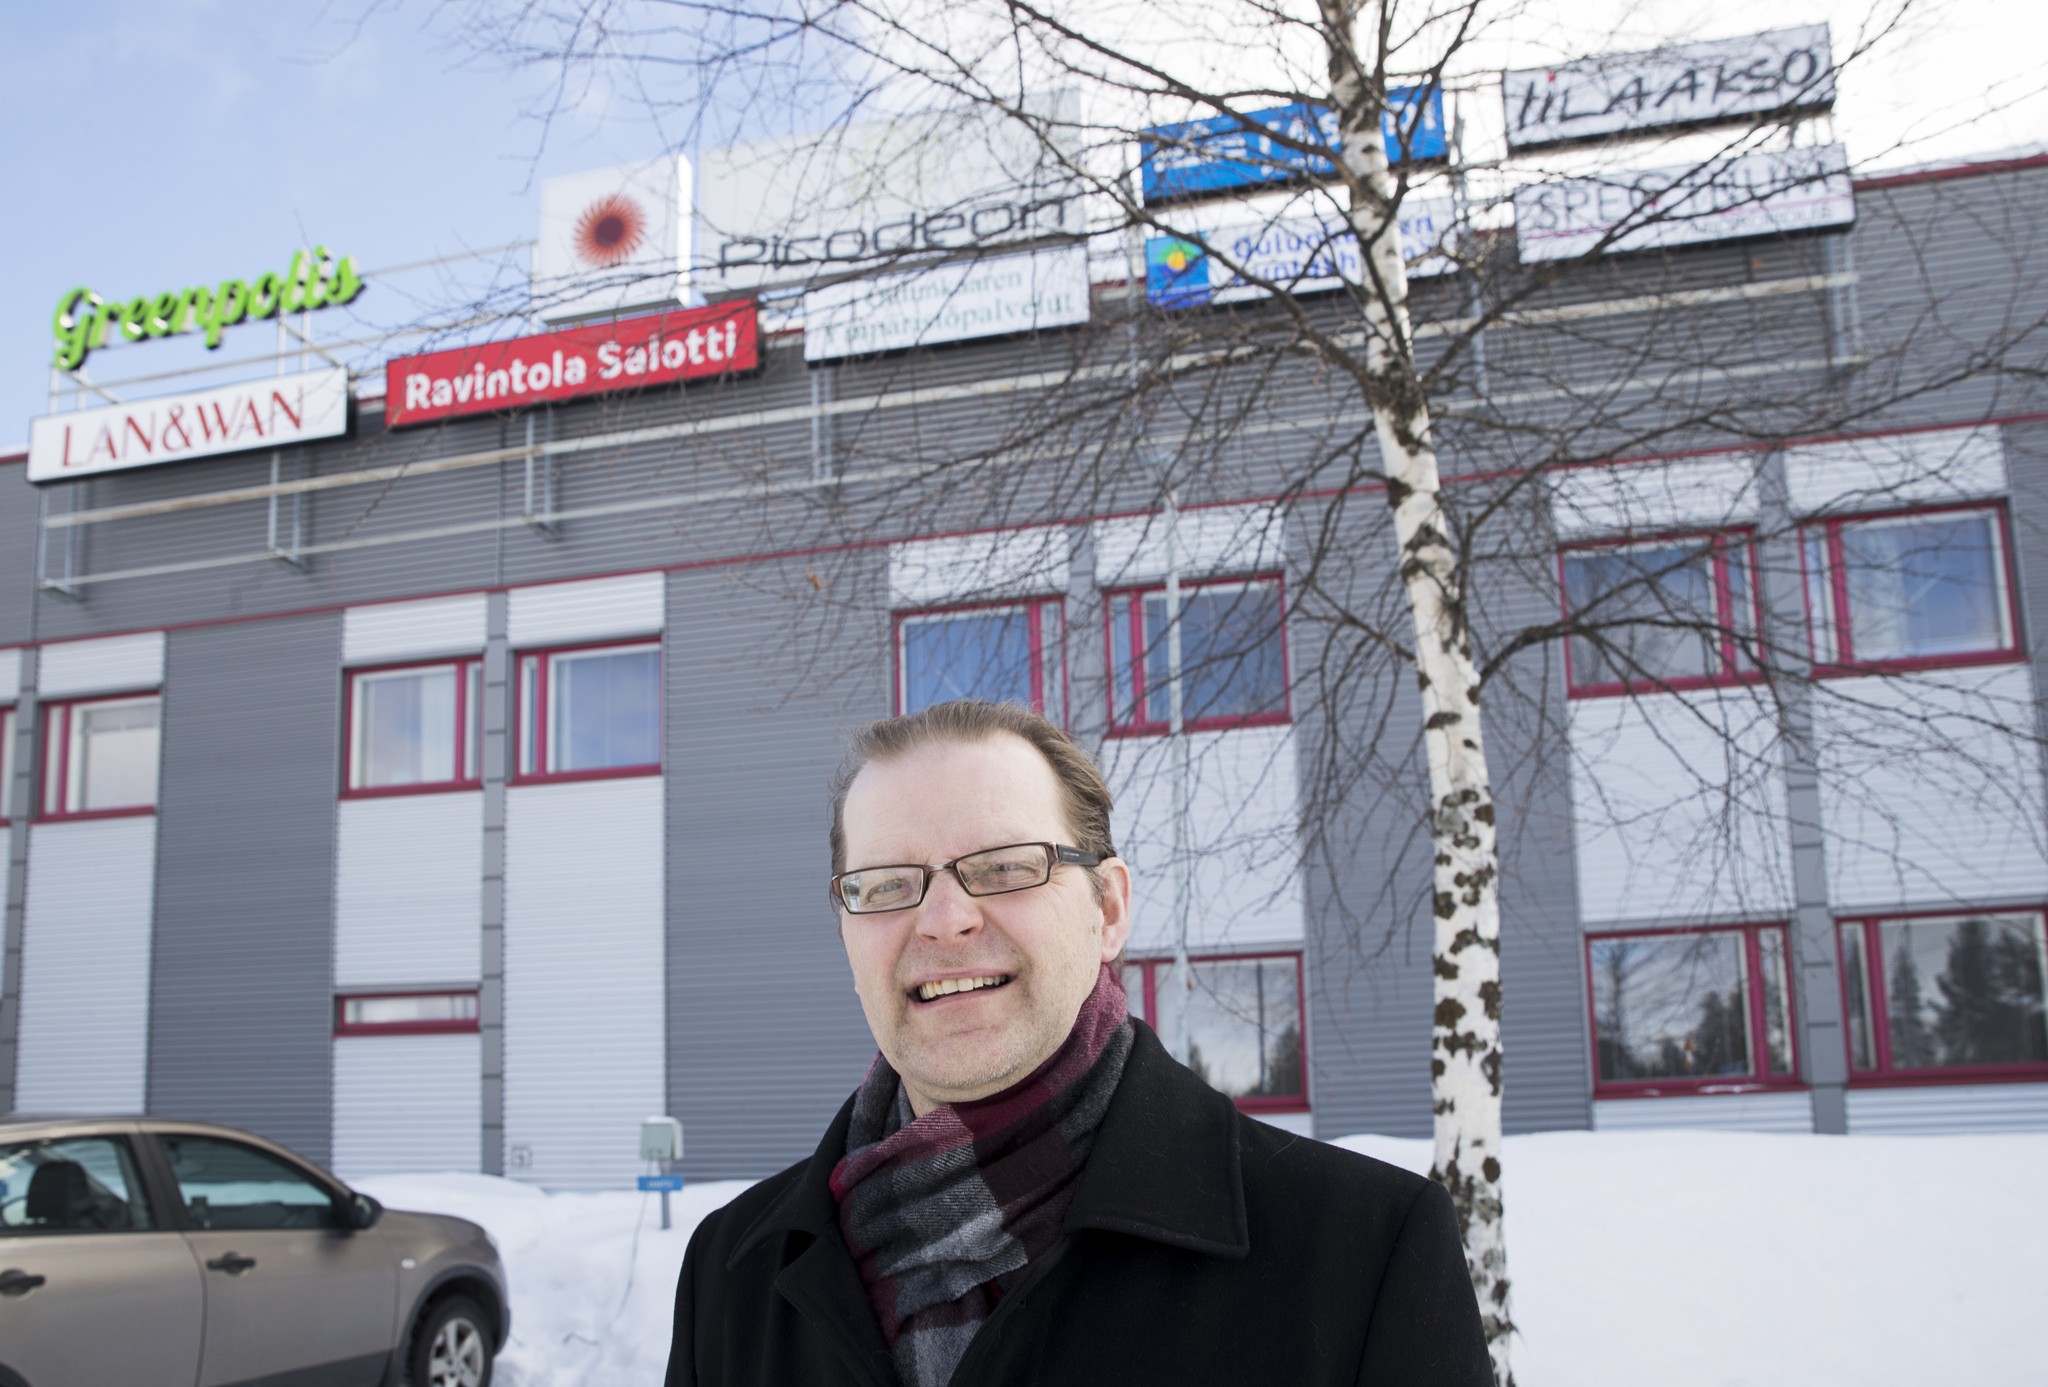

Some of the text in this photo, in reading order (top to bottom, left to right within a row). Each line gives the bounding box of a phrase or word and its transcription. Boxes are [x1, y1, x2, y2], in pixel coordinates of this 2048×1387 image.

[720, 200, 1066, 278] picodeon
[53, 245, 365, 371] Greenpolis
[406, 320, 737, 410] Ravintola Salotti
[62, 387, 304, 467] LAN&WAN
